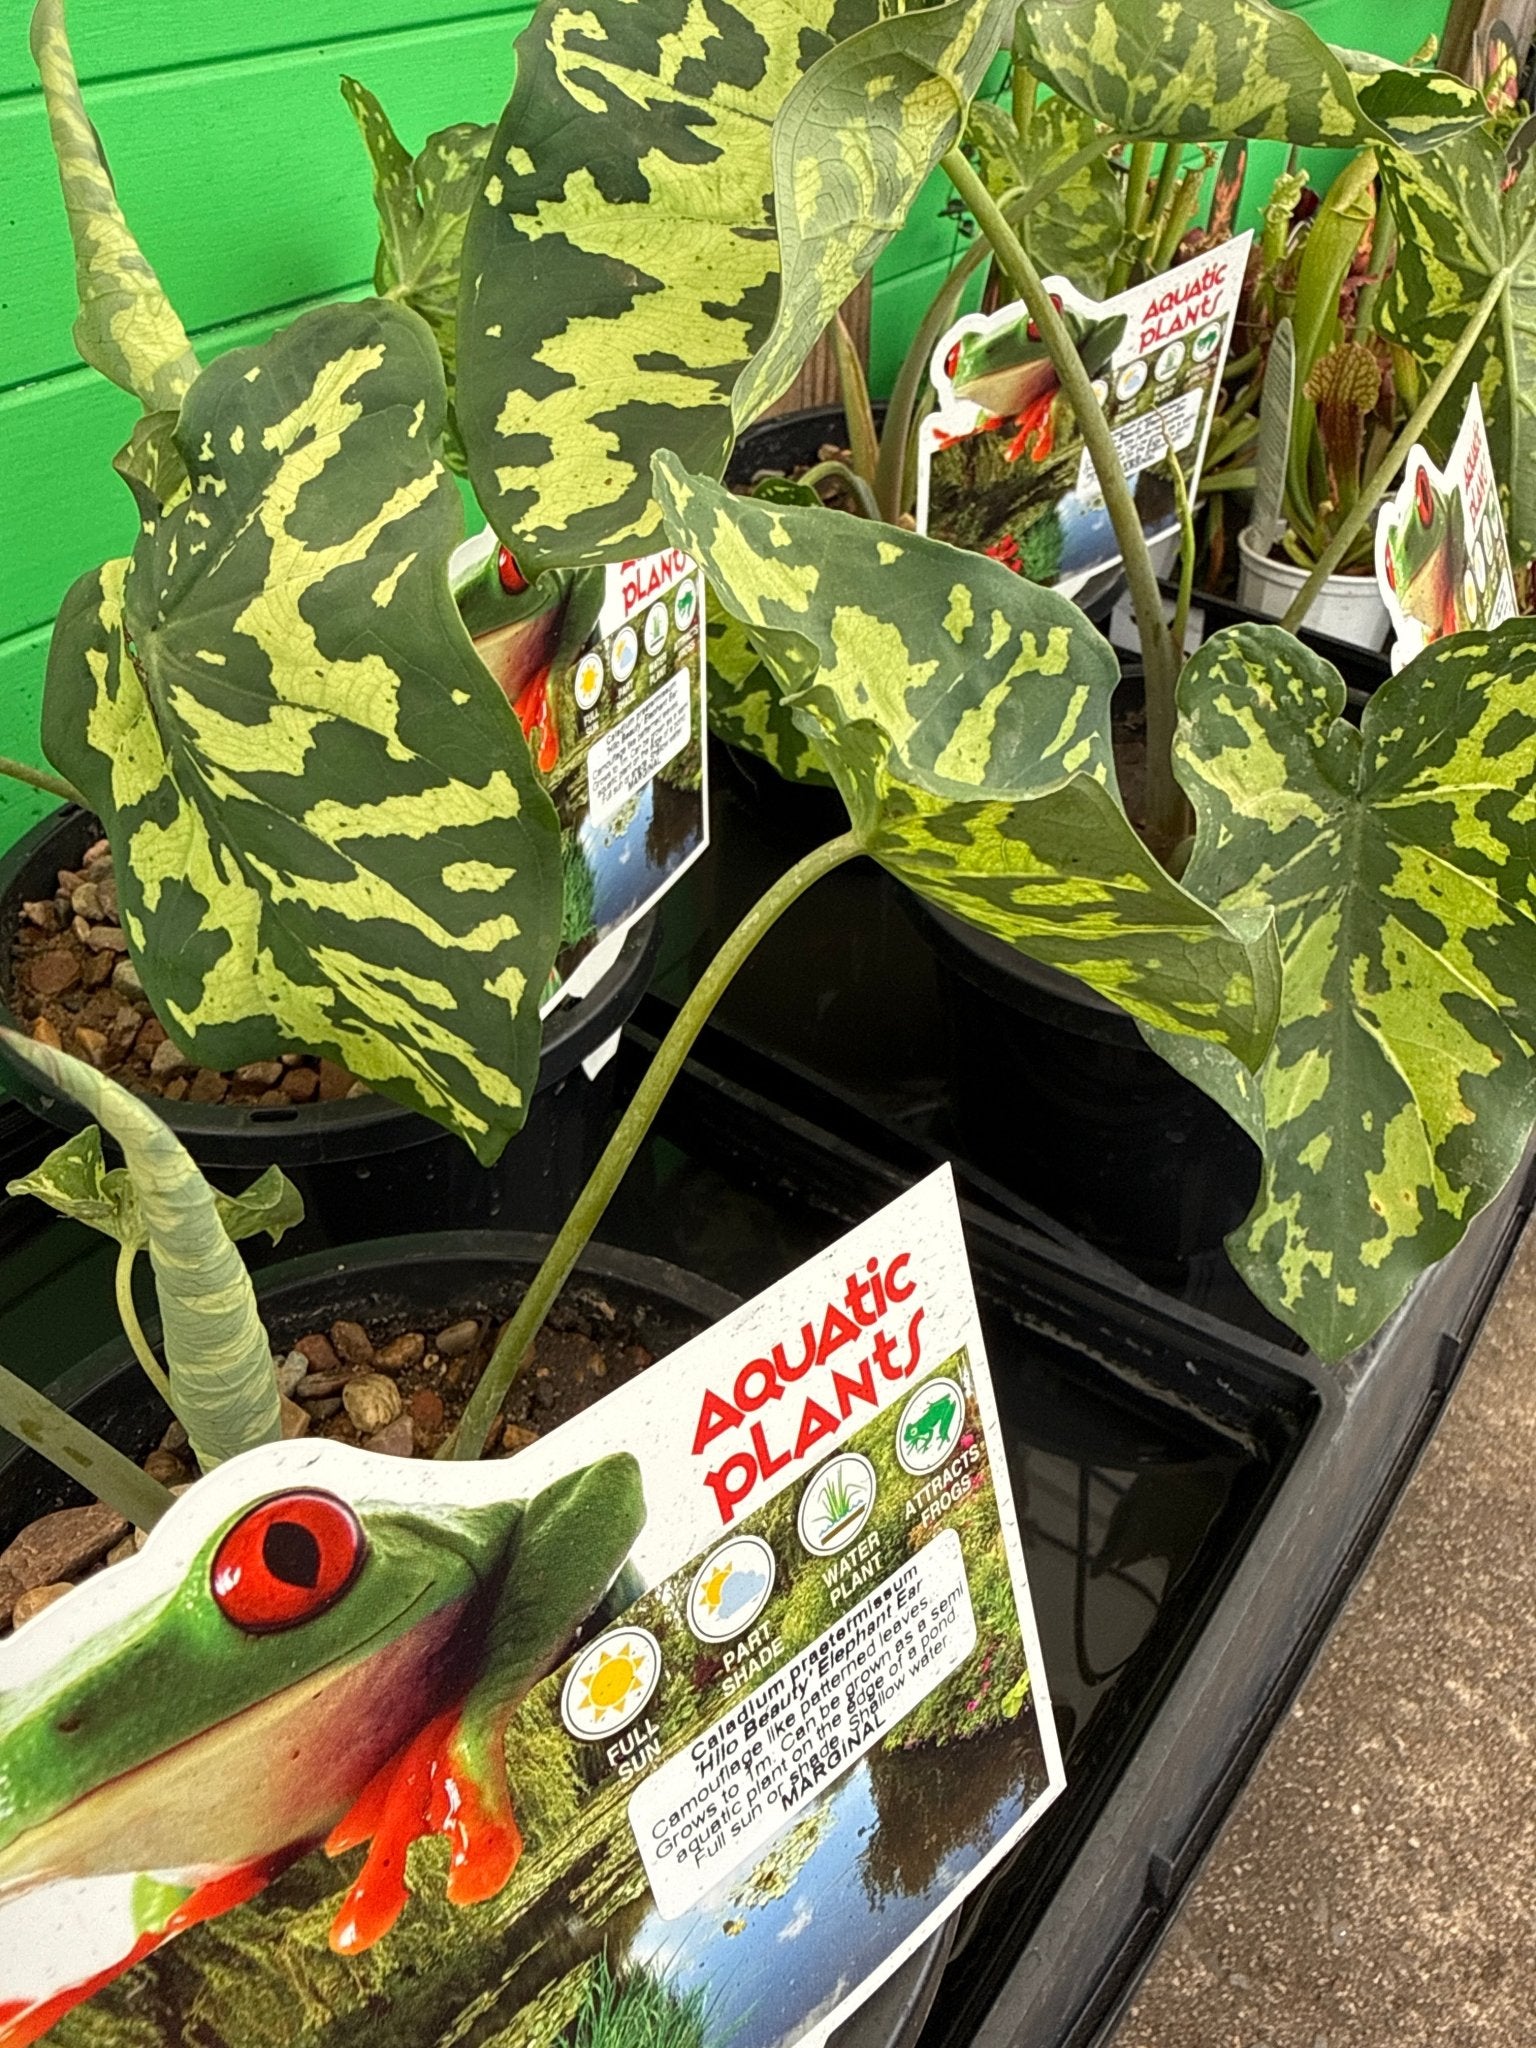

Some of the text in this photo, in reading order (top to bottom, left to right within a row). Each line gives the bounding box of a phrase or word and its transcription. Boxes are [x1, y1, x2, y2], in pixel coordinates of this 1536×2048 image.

[904, 1445, 981, 1521] ATTRACTS
[921, 1474, 972, 1529] FROGS
[821, 1531, 881, 1589] WATER
[830, 1552, 883, 1608] PLANT
[691, 1565, 918, 1761] Caladium praetermissum
[723, 1620, 772, 1670] PART
[818, 1604, 892, 1678] Elephant
[897, 1578, 923, 1609] Ear
[722, 1638, 785, 1697] SHADE
[606, 1718, 660, 1767] FULL
[652, 1742, 763, 1839] Camouflage
[767, 1713, 795, 1744] like
[800, 1639, 876, 1719] patterned
[656, 1803, 717, 1859] Grows
[722, 1784, 739, 1803] to
[781, 1717, 816, 1751] Can
[820, 1696, 840, 1720] be
[845, 1651, 891, 1700] grown
[895, 1631, 913, 1653] as
[918, 1619, 926, 1632] a
[931, 1581, 964, 1620] semi
[677, 1801, 742, 1863] aquatic
[746, 1758, 788, 1807] plant
[792, 1739, 813, 1762] on
[817, 1714, 841, 1741] the
[847, 1676, 884, 1715] edge
[889, 1654, 902, 1676] of
[908, 1647, 916, 1660] a
[618, 1738, 661, 1783] SUN
[695, 1832, 726, 1868] Full
[731, 1804, 762, 1837] sun
[767, 1782, 783, 1804] or
[849, 1675, 905, 1732] Shallow
[782, 1714, 886, 1812] MARGINAL
